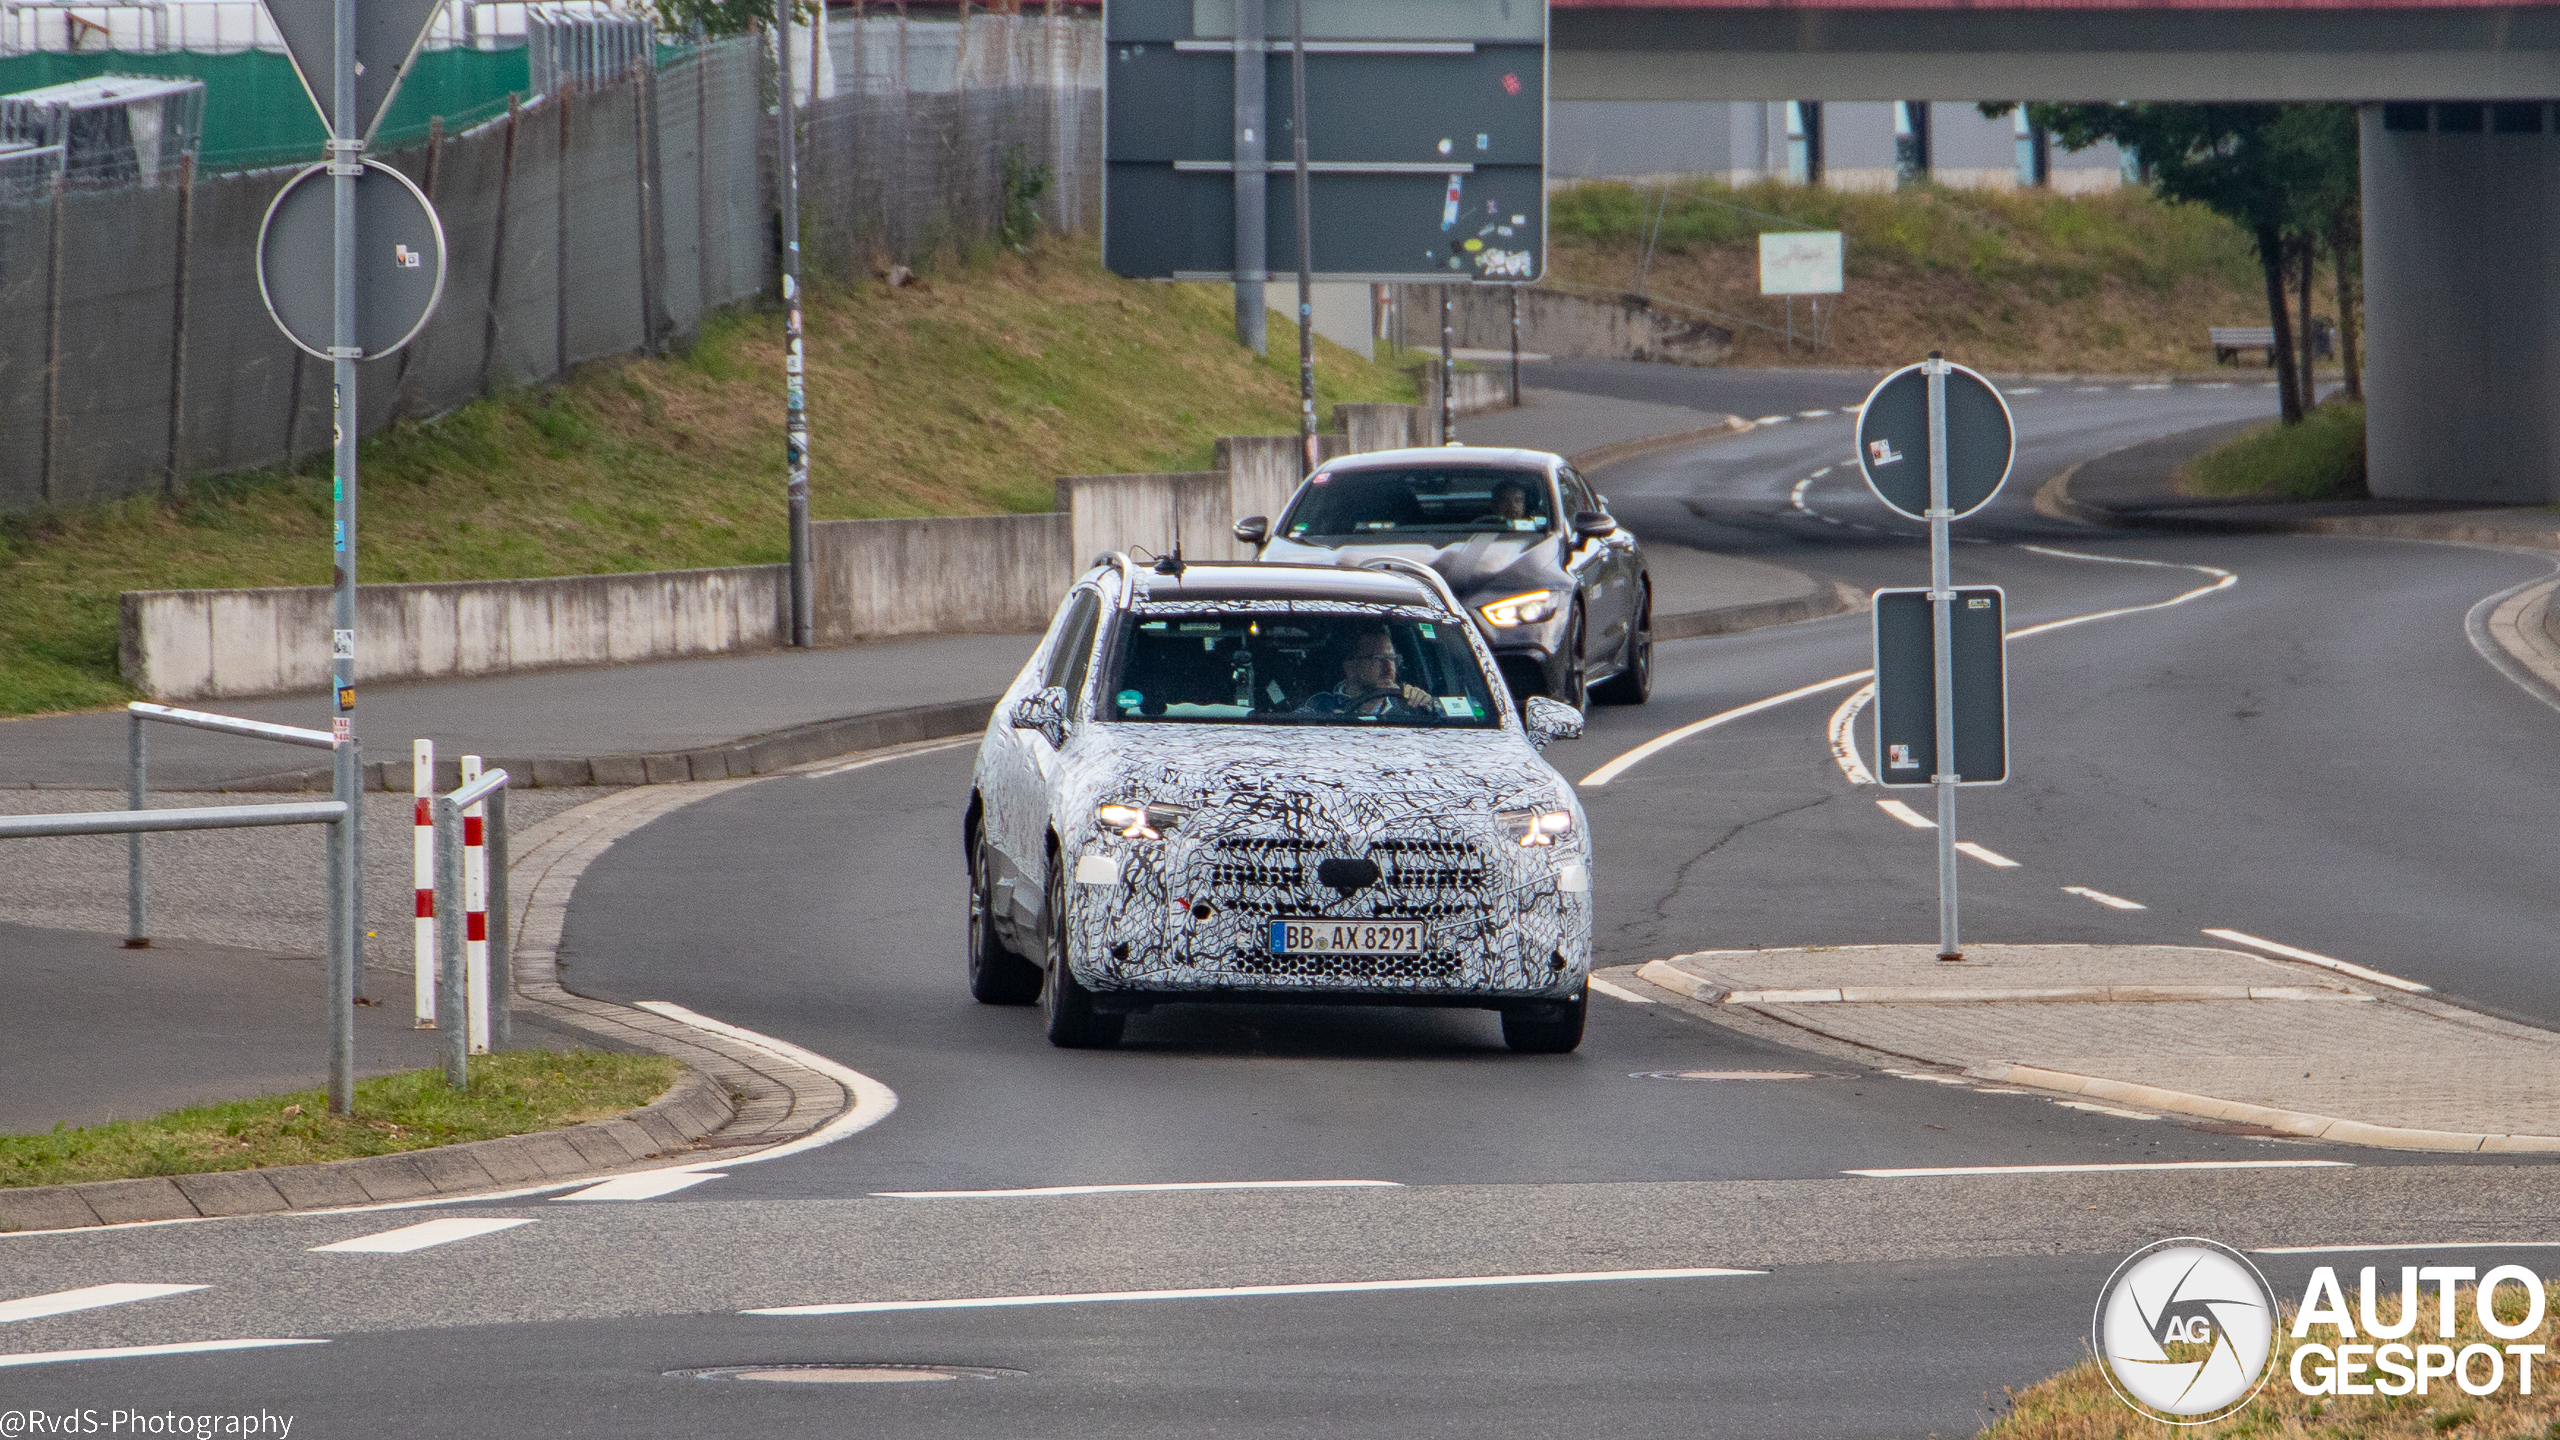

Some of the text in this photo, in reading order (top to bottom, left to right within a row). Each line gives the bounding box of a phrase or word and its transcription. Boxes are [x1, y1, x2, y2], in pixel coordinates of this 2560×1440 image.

[1286, 926, 1418, 950] BB AX 8291
